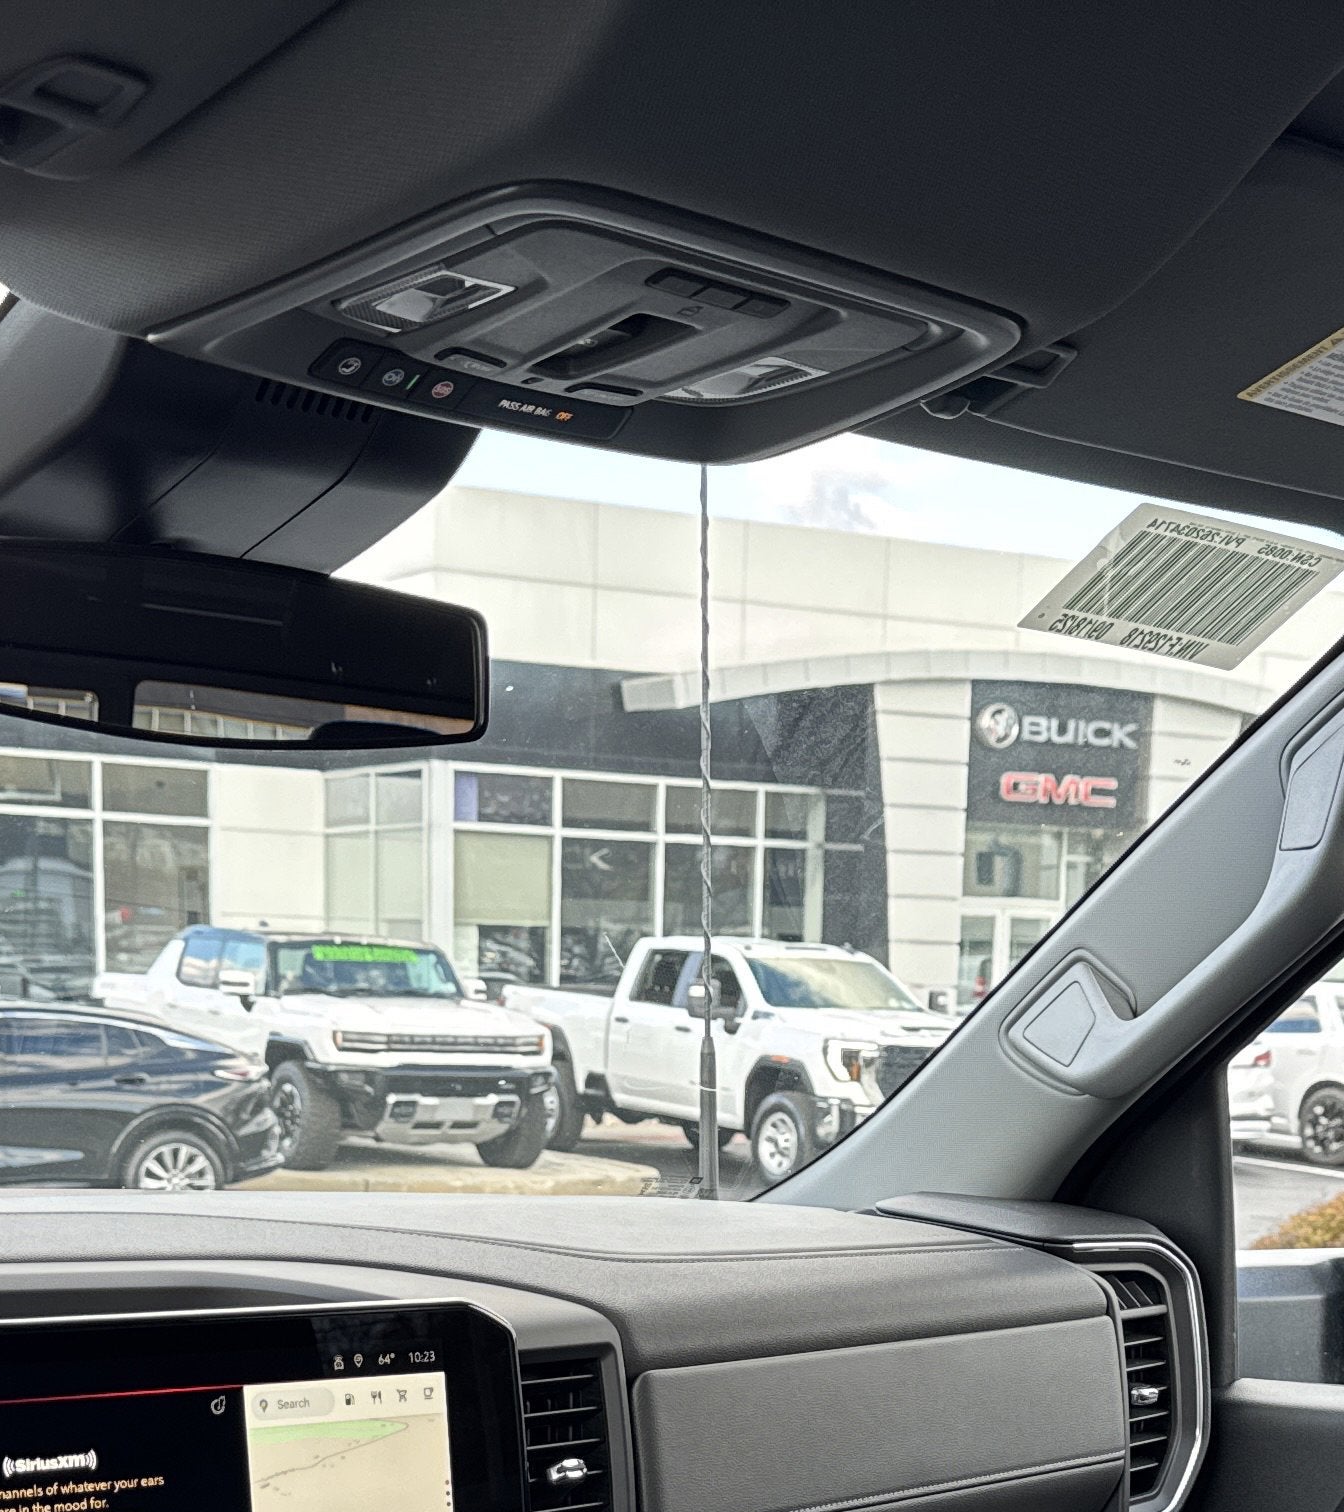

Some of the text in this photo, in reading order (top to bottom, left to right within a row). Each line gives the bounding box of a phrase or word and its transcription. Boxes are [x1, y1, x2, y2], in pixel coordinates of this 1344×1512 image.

[498, 399, 522, 411] PASS
[519, 404, 536, 413] AIR
[1022, 715, 1139, 749] BUICK
[999, 771, 1118, 808] GMC
[408, 1350, 436, 1364] 10:23
[277, 1397, 310, 1410] Search
[45, 1481, 59, 1495] of
[60, 1479, 111, 1494] whatever
[113, 1478, 138, 1492] your
[140, 1475, 164, 1487] ears
[53, 1498, 88, 1512] mood
